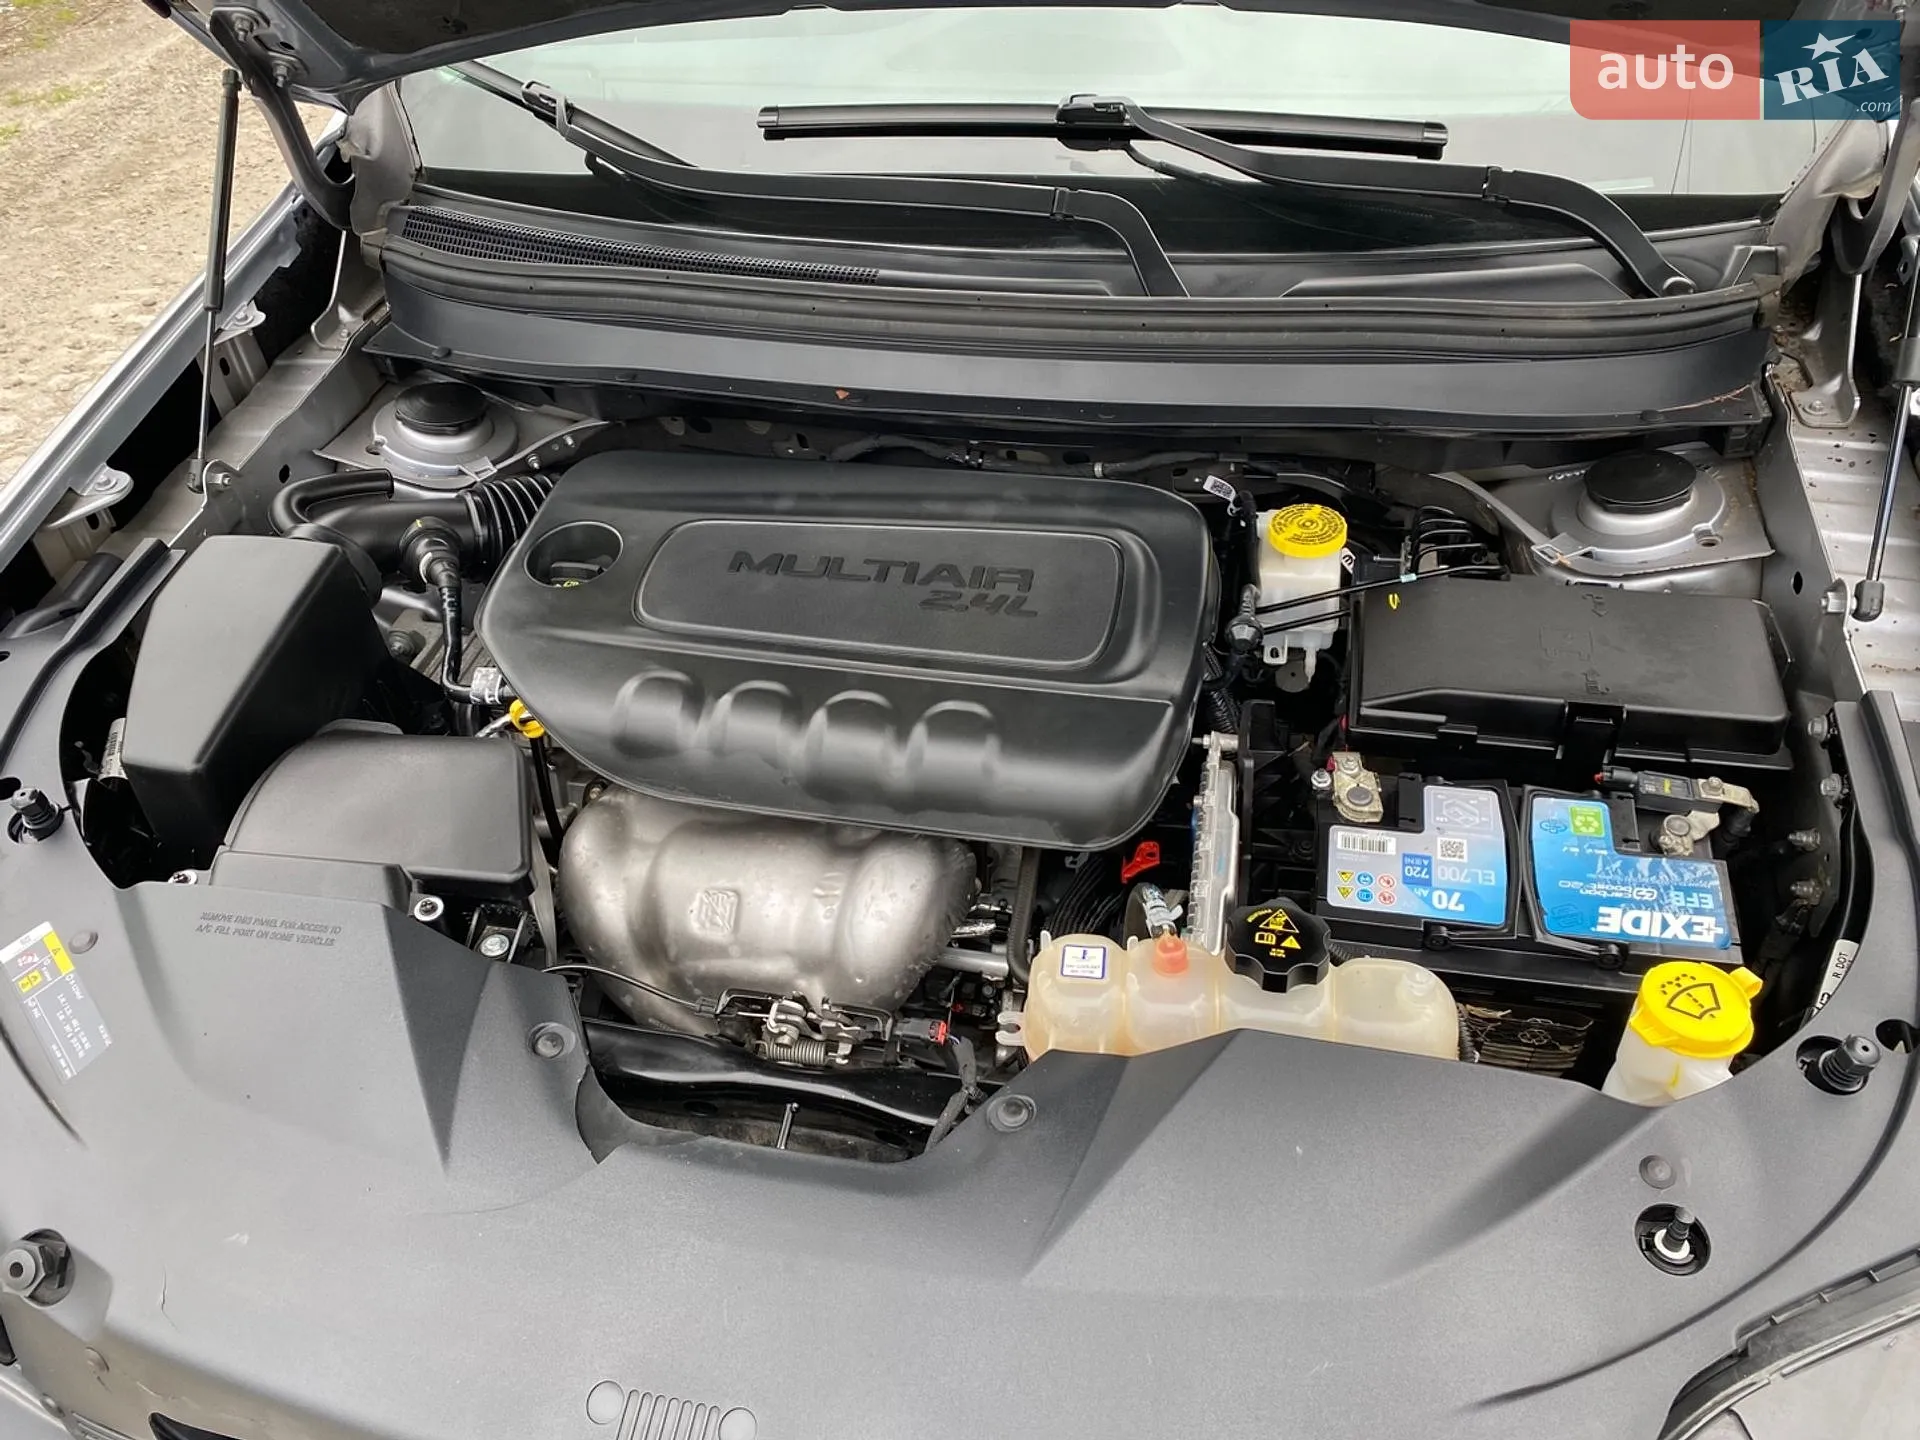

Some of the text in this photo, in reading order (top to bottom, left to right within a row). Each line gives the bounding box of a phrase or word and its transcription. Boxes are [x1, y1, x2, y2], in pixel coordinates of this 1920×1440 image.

[727, 549, 1036, 592] MULTIAIR
[916, 589, 1040, 619] 2.4L
[1405, 865, 1430, 879] 720
[1437, 865, 1496, 885] EL700
[1414, 888, 1466, 913] 70 Ah
[1670, 890, 1715, 909] EFB
[195, 923, 213, 933] A/C
[1596, 906, 1724, 943] EXIDE
[1835, 952, 1848, 969] DOT
